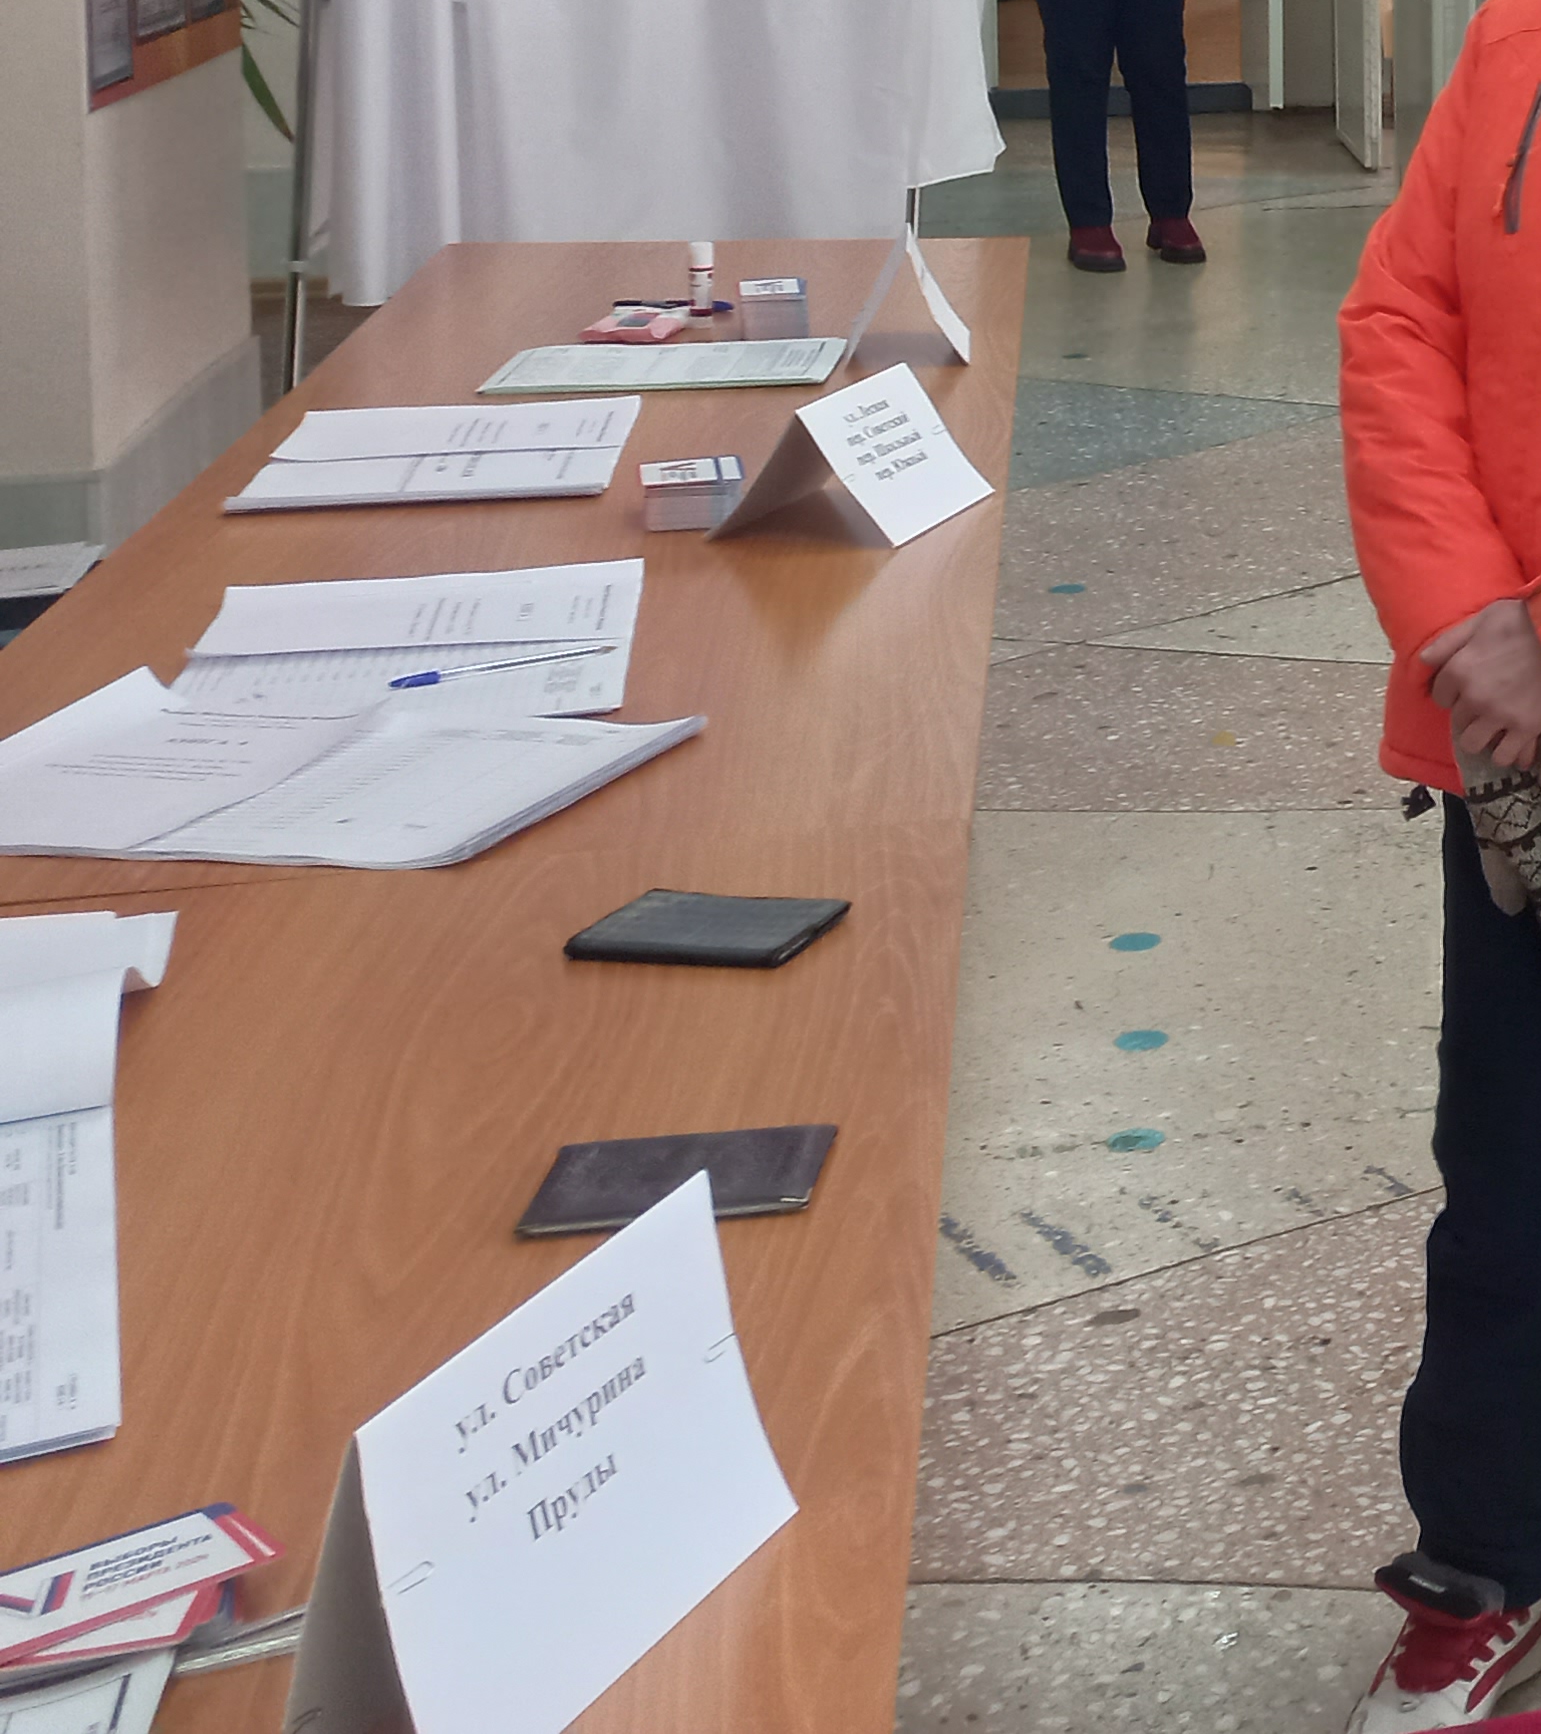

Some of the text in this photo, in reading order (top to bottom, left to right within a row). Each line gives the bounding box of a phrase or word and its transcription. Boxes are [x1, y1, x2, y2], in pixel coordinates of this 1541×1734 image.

[454, 1292, 636, 1454] ул. Советская
[465, 1356, 647, 1523] ул. Мичурина
[526, 1453, 619, 1541] Пруды
